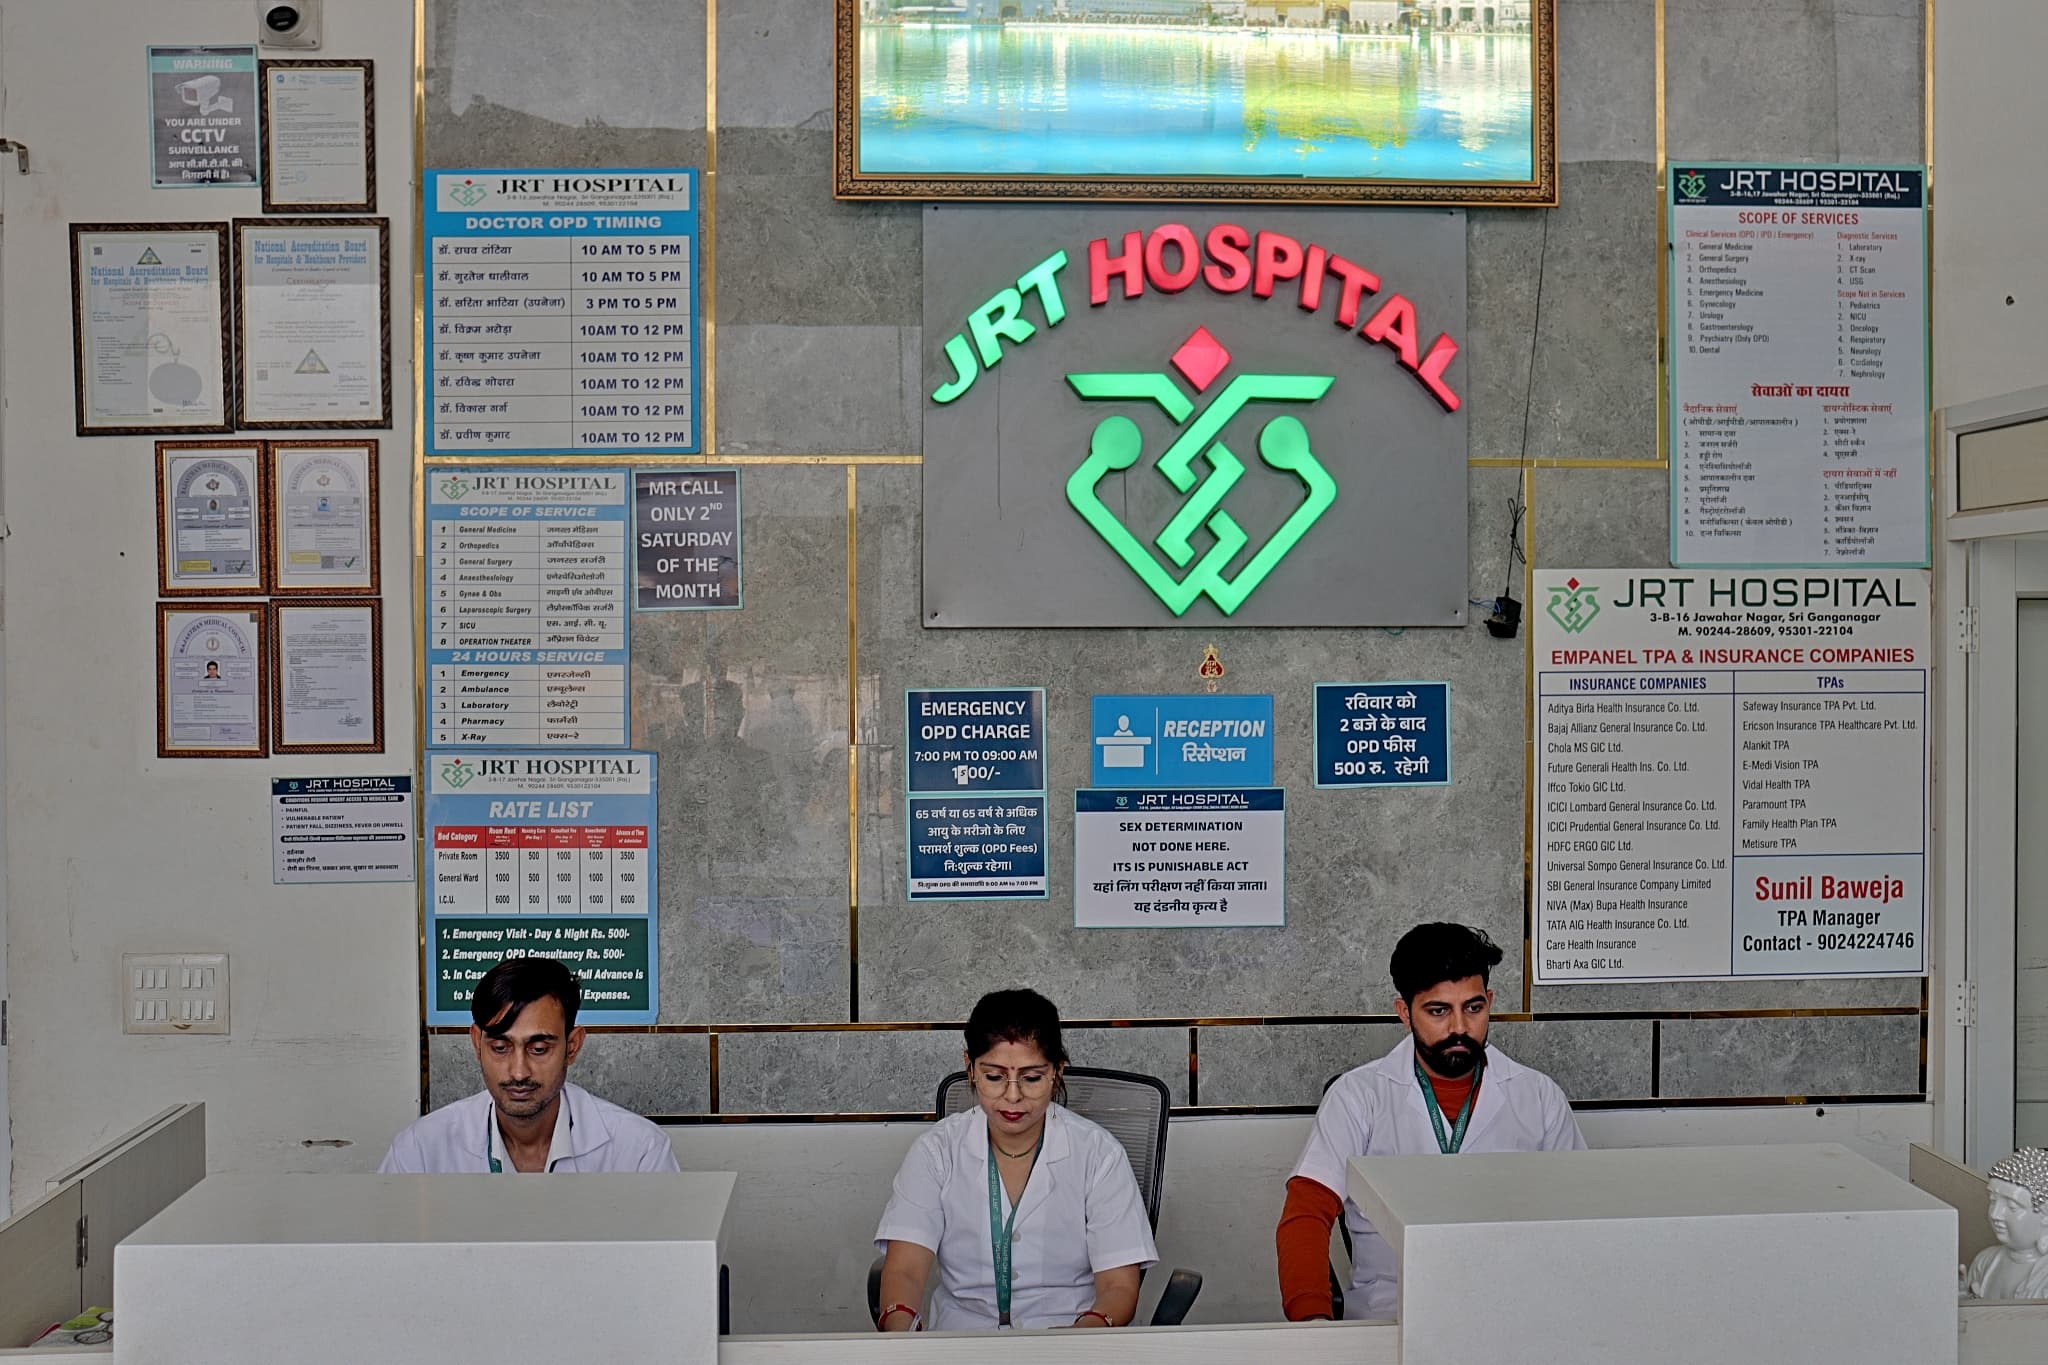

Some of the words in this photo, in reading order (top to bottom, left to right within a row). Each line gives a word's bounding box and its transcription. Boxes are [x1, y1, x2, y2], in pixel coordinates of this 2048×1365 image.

[173, 59, 233, 71] WARNING
[165, 118, 185, 127] YOU
[187, 118, 206, 127] ARE
[208, 118, 241, 126] UNDER
[181, 128, 226, 143] CCTV
[169, 145, 239, 155] SURVEILLANCE
[497, 179, 545, 194] JRT
[554, 179, 683, 193] HOSPITAL
[1721, 171, 1772, 190] JRT
[1781, 171, 1910, 192] HOSPITAL
[466, 217, 544, 230] DOCTOR
[549, 217, 588, 229] OPD
[593, 216, 662, 229] TIMING
[1739, 212, 1778, 225] SCOPE
[1782, 212, 1797, 225] OF
[1801, 213, 1859, 225] SERVICES
[438, 244, 451, 255] डॉ.
[454, 247, 479, 255] राघव
[481, 243, 513, 255] टांटिया
[582, 245, 597, 256] 10
[601, 245, 622, 256] AM
[626, 245, 645, 256] TO
[649, 244, 657, 255] 5
[661, 244, 680, 255] PM
[931, 249, 1068, 404] JRT
[1088, 223, 1462, 413] HOSPITAL
[1751, 383, 1794, 397] सेवाओं
[1795, 386, 1813, 397] का
[1816, 386, 1850, 397] दायरा
[472, 477, 510, 490] JRT
[516, 477, 616, 490] HOSPITAL
[648, 481, 677, 496] MR
[681, 480, 724, 496] CALL
[460, 507, 508, 517] SCOPE
[513, 507, 532, 517] OF
[535, 506, 597, 517] SERVICE
[641, 532, 733, 548] SATURDAY
[657, 558, 680, 573] OF
[684, 558, 718, 573] THE
[656, 583, 721, 599] MONTH
[1613, 579, 1695, 608] JRT
[1710, 578, 1917, 607] HOSPITAL
[1650, 613, 1690, 622] 3-B-16
[1693, 612, 1743, 622] Jawahar
[1746, 612, 1785, 624] Nagar,
[1789, 612, 1804, 622] Sri
[1807, 612, 1881, 624] Ganganagar
[1678, 627, 1692, 636] M.
[1696, 626, 1775, 638] 90244-28609,
[1778, 626, 1853, 636] 95301-22104
[459, 638, 499, 646] OPERATION
[500, 638, 532, 646] THEATER
[452, 651, 471, 662] 24
[475, 651, 532, 662] HOURS
[536, 652, 604, 662] SERVICE
[1552, 650, 1638, 665] EMPANEL
[1642, 650, 1677, 664] TPA
[1682, 649, 1694, 664] &
[1700, 649, 1804, 664] INSURANCE
[1810, 648, 1915, 663] COMPANIES
[461, 670, 510, 679] Emergency
[1570, 678, 1636, 691] INSURANCE
[1640, 677, 1707, 690] COMPANIES
[1817, 677, 1844, 689] TPAs
[1345, 693, 1394, 710] रविवार
[1396, 691, 1417, 709] को
[922, 701, 1026, 716] EMERGENCY
[1164, 720, 1266, 738] RECEPTION
[1340, 719, 1349, 732] 2
[1352, 714, 1378, 732] बजे
[1380, 713, 1397, 731] के
[1399, 717, 1427, 732] बाद
[461, 733, 487, 742] X-Ray
[922, 725, 957, 740] OPD
[962, 725, 1030, 739] CHARGE
[1182, 742, 1247, 762] रिसेप्शन
[1347, 740, 1380, 754] OPD
[1383, 735, 1417, 753] फीस
[915, 751, 940, 762] 7:00
[943, 751, 961, 761] PM
[964, 751, 979, 761] TO
[982, 750, 1017, 761] 09:00
[1019, 750, 1038, 760] AM
[478, 760, 520, 776] JRT
[527, 760, 641, 775] HOSPITAL
[1335, 762, 1366, 776] 500
[1368, 761, 1386, 775] रु.
[1394, 756, 1430, 776] रहेगी
[305, 779, 330, 789] JRT
[334, 778, 396, 788] HOSPITAL
[1137, 795, 1168, 805] JRT
[1172, 794, 1250, 805] HOSPITAL
[489, 801, 542, 818] RATE
[547, 801, 594, 818] LIST
[916, 810, 929, 819] 65
[931, 807, 947, 819] वर्ष
[948, 809, 961, 819] या
[962, 809, 976, 819] 65
[977, 806, 994, 818] वर्ष
[995, 806, 1005, 818] से
[1006, 806, 1038, 818] अधिक
[928, 827, 949, 840] आयु
[950, 824, 962, 836] के
[963, 824, 992, 836] मरीजो
[993, 824, 1004, 836] के
[1006, 823, 1026, 836] लिए
[1120, 822, 1142, 832] SEX
[1145, 822, 1243, 832] DETERMINATION
[918, 842, 953, 855] परामर्श
[954, 844, 980, 857] शुल्क
[982, 844, 1008, 855] (OPD
[1010, 843, 1038, 854] Fees)
[1133, 842, 1157, 852] NOT
[1160, 842, 1193, 852] DONE
[1196, 842, 1230, 851] HERE.
[1113, 863, 1132, 872] ITS
[1135, 862, 1146, 872] IS
[1148, 862, 1224, 872] PUNISHABLE
[1227, 862, 1249, 871] ACT
[1093, 880, 1114, 894] यहां
[1116, 880, 1140, 892] लिंग
[1142, 879, 1183, 892] परीक्षण
[1185, 879, 1207, 893] नहीं
[1207, 879, 1236, 891] किया
[1237, 881, 1267, 891] जाता।
[1756, 876, 1812, 901] Sunil
[1822, 875, 1903, 904] Baweja
[1134, 902, 1152, 913] यह
[1153, 899, 1191, 913] दंडनीय
[1192, 902, 1218, 915] कृत्य
[1219, 898, 1228, 913] है
[1777, 910, 1807, 927] TPA
[1813, 910, 1881, 929] Manager
[443, 928, 451, 939] 1.
[453, 929, 504, 942] Emergency
[506, 928, 527, 939] Visit
[534, 928, 553, 942] Day
[555, 928, 562, 939] &
[564, 928, 589, 941] Night
[591, 928, 606, 939] Rs.
[608, 928, 630, 939] 500/-
[1743, 935, 1801, 952] Contact
[1818, 932, 1914, 950] 9024224746
